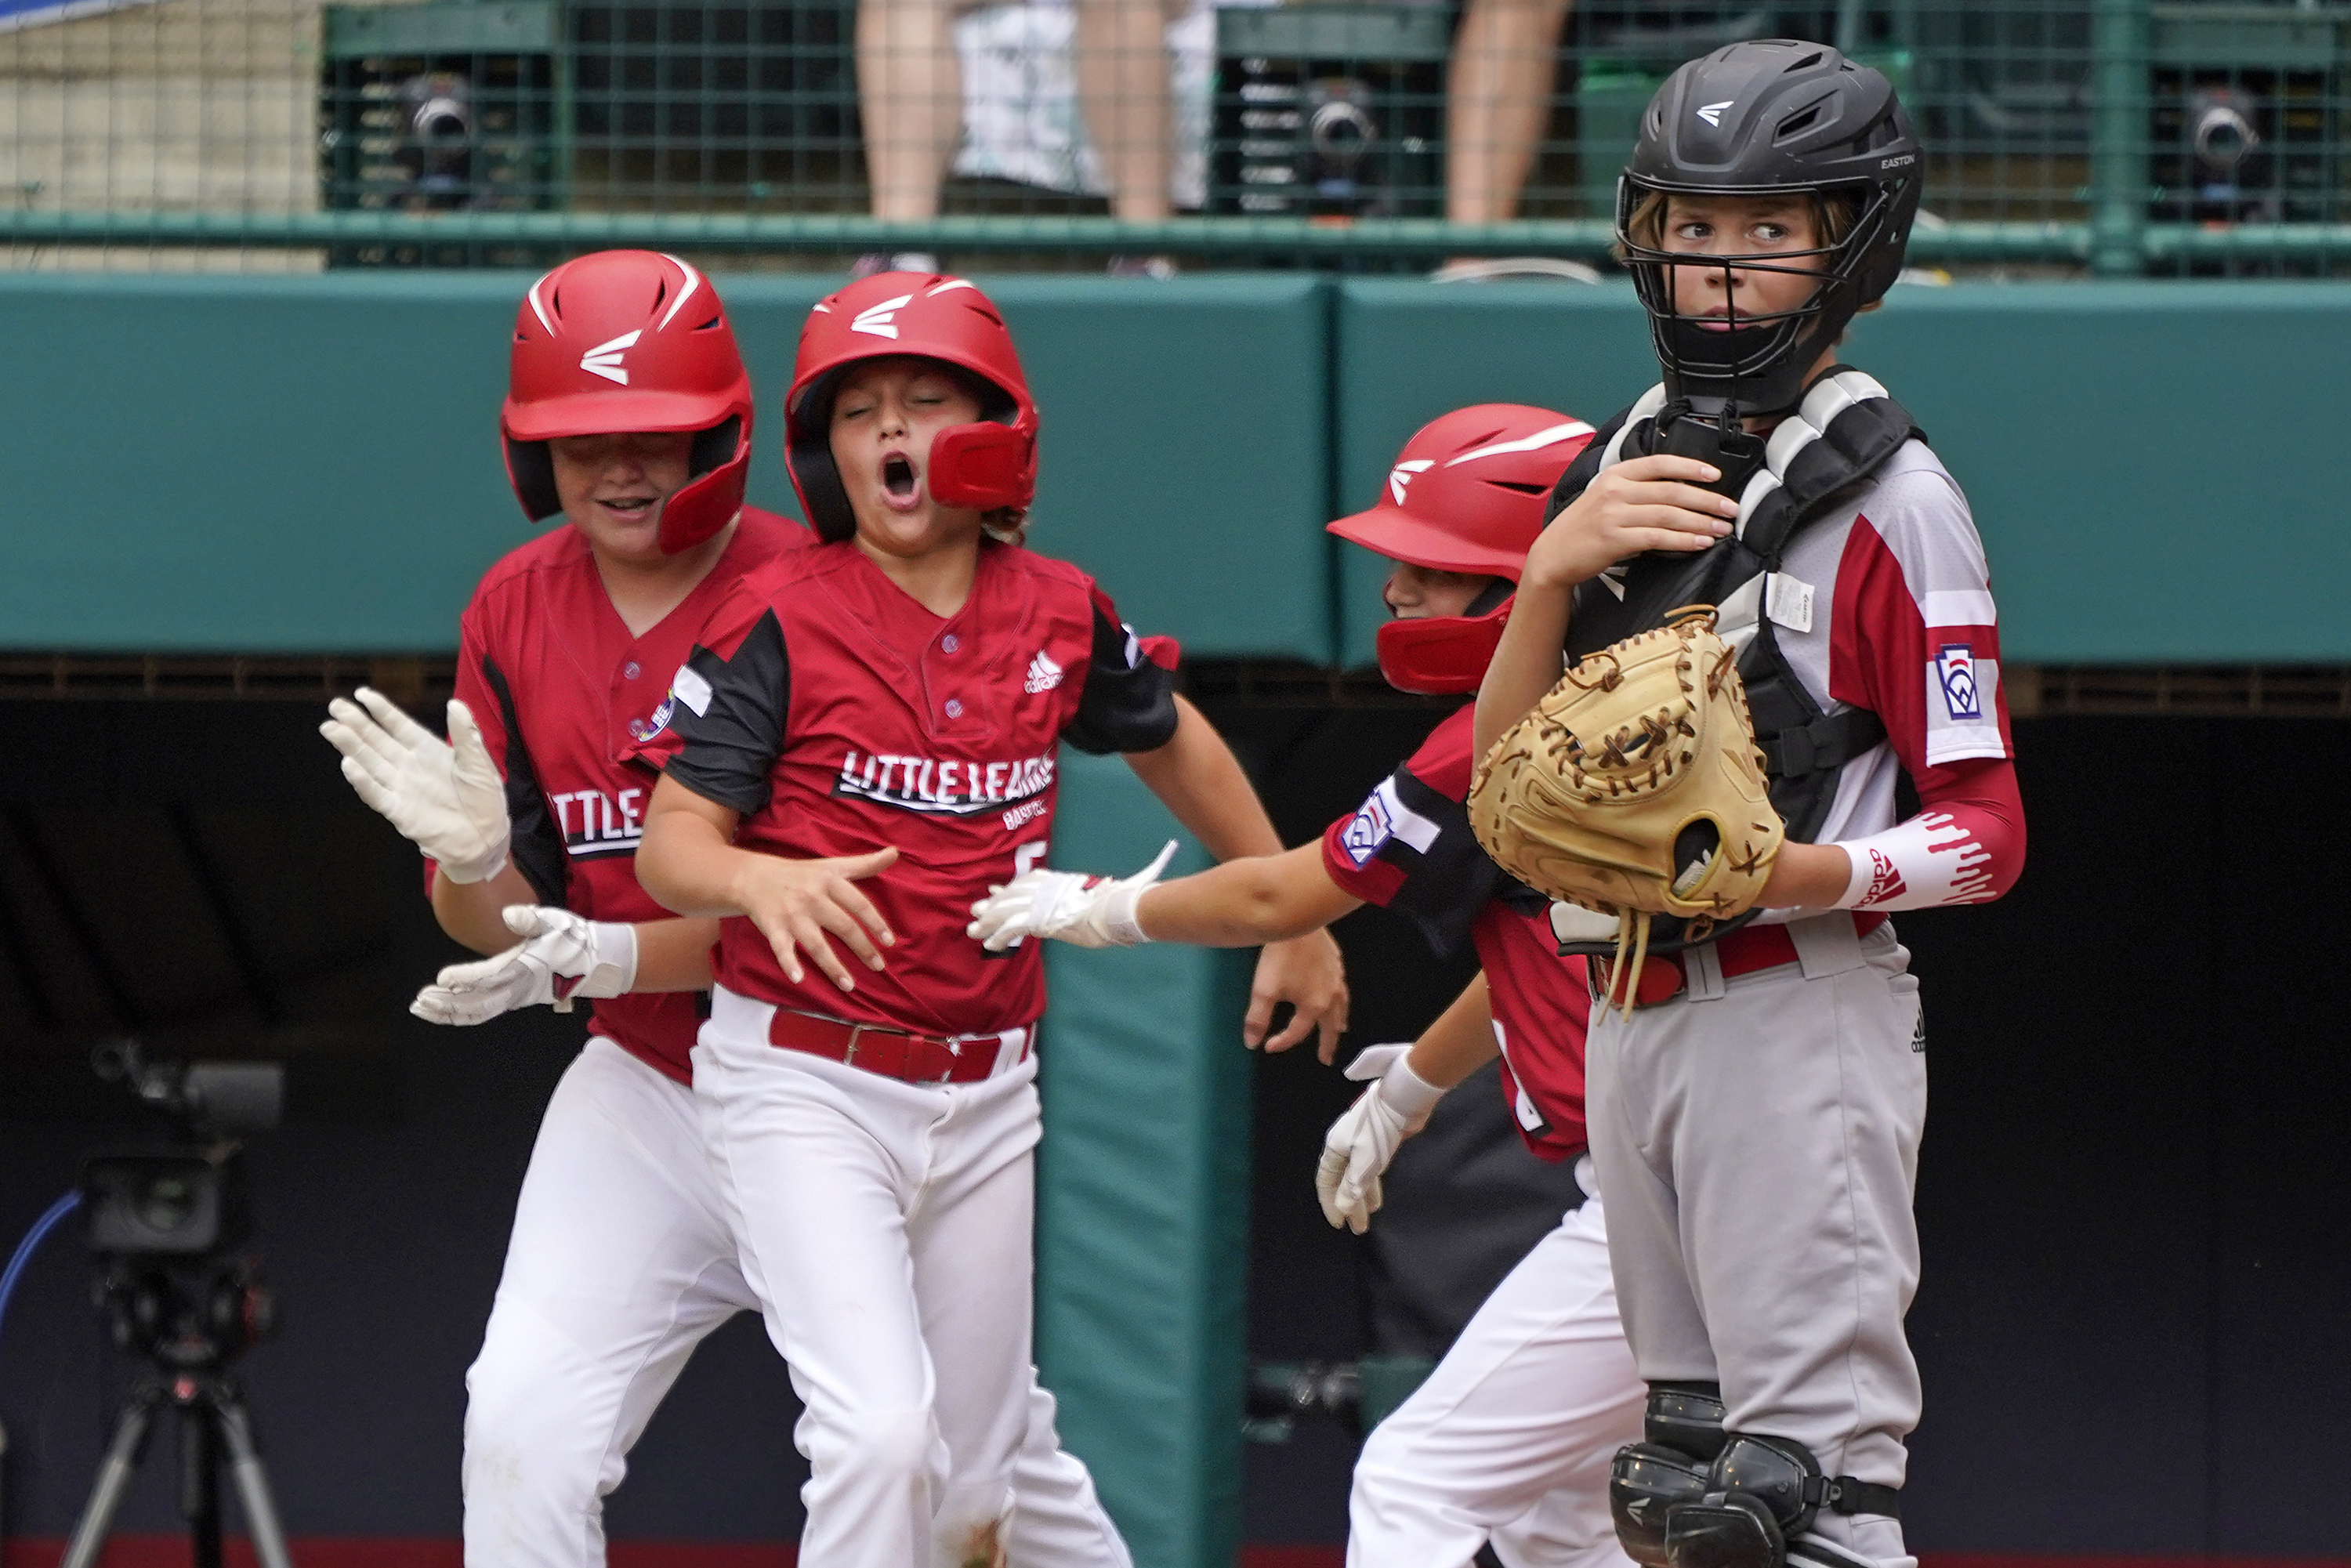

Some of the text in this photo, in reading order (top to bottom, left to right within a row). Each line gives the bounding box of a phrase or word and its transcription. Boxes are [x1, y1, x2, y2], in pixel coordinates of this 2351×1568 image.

[1882, 154, 1915, 170] EASTON
[841, 751, 1055, 804] LITTLE LEAG
[547, 788, 643, 842] TTLE
